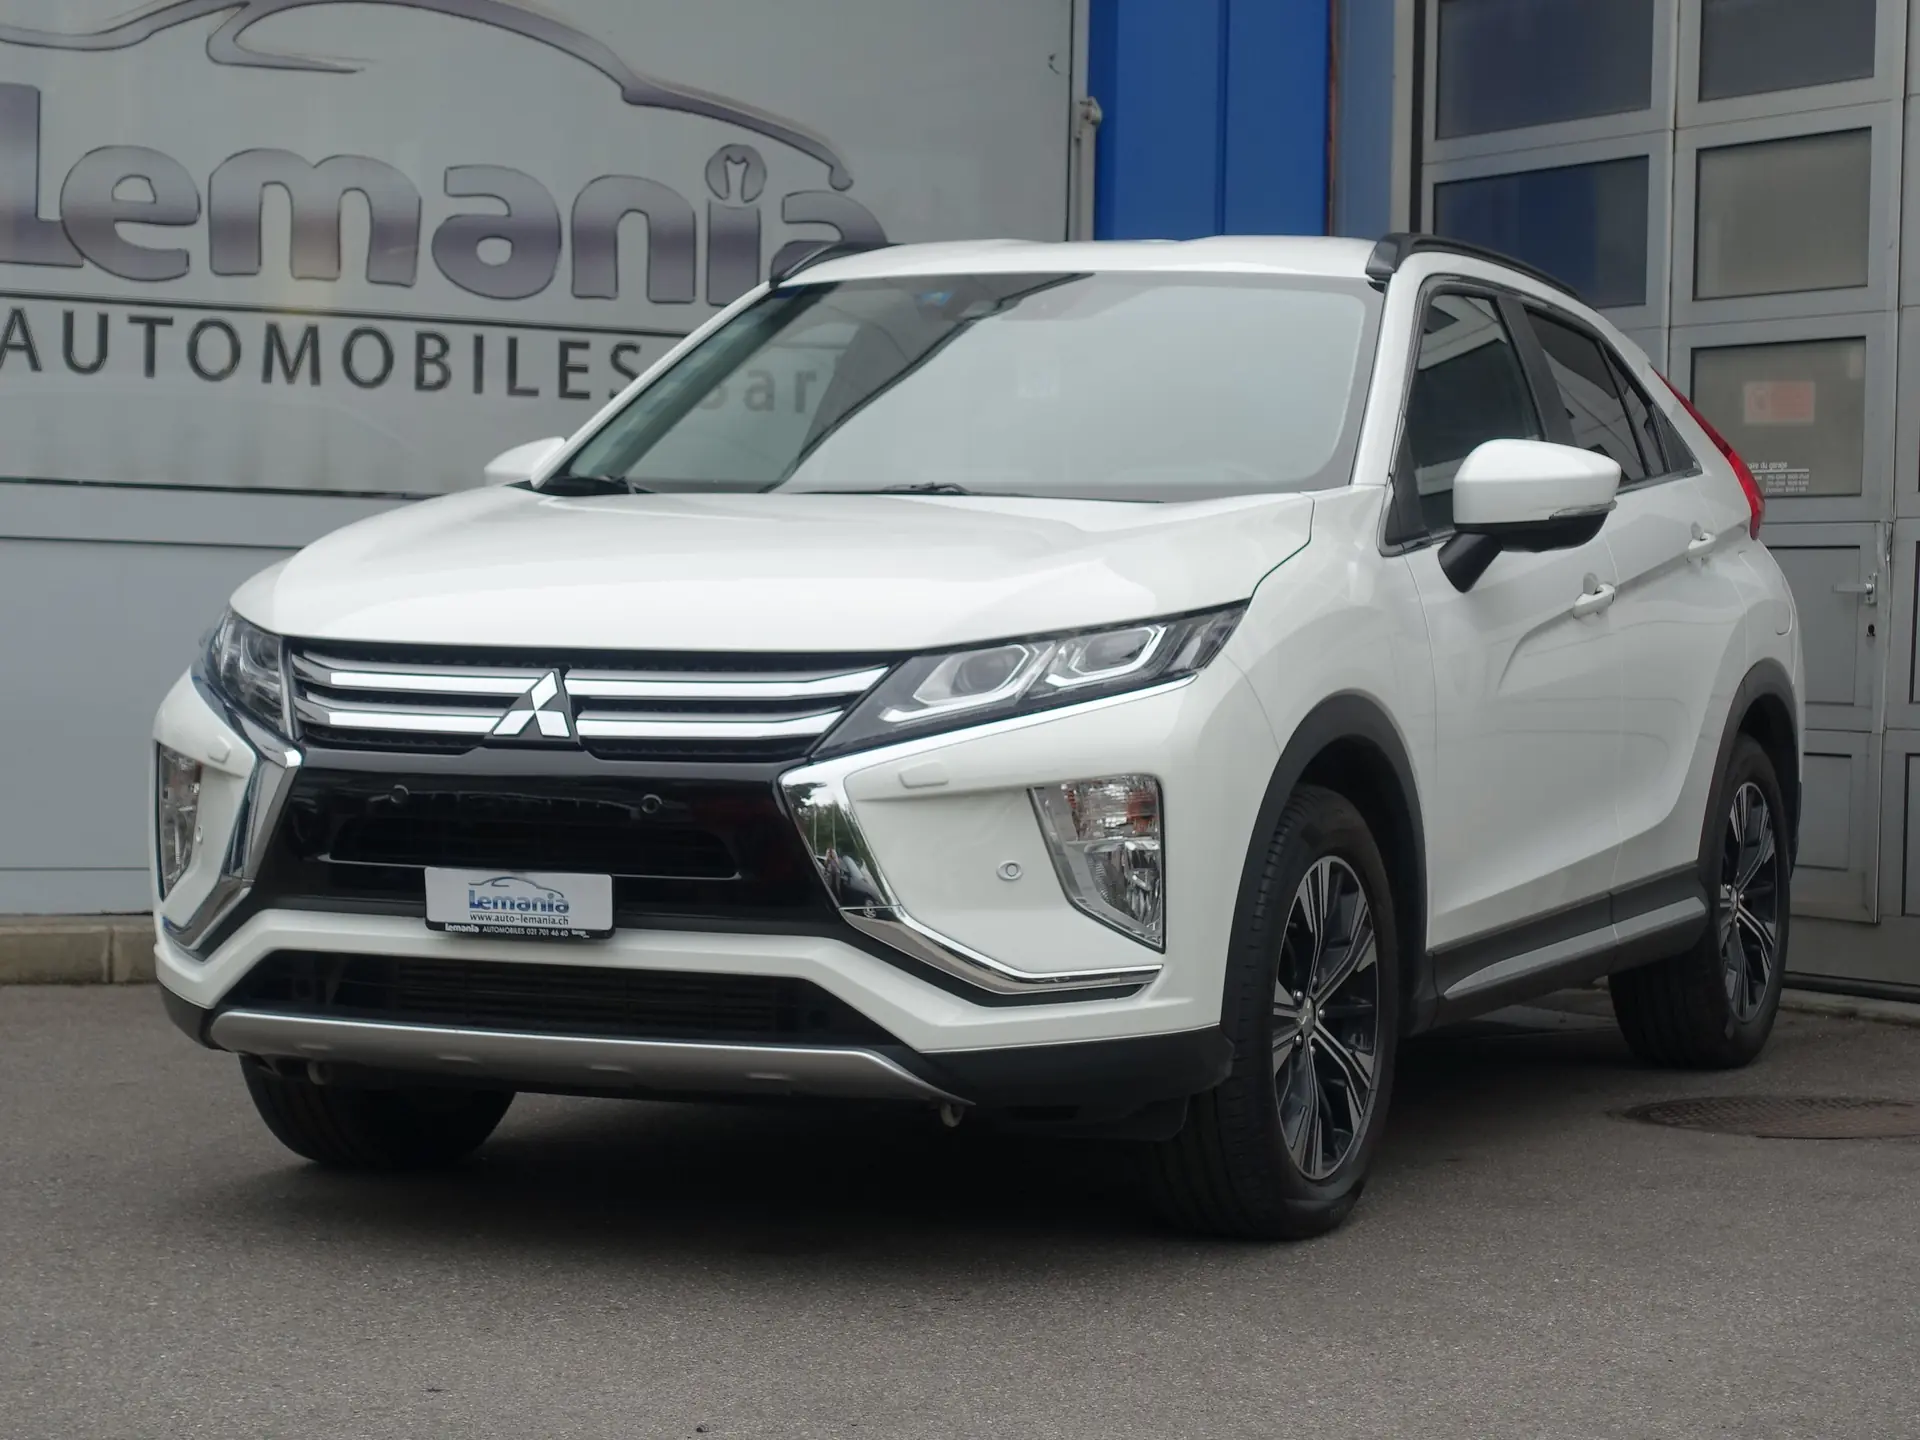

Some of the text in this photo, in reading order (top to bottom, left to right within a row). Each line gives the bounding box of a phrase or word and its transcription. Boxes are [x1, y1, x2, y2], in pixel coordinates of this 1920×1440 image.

[0, 84, 888, 307] Lemania
[0, 306, 641, 400] AUTOMOBILES
[468, 890, 569, 913] Lemania
[444, 922, 480, 933] Lemania
[482, 926, 526, 935] AUTOMOBILES
[469, 912, 569, 926] www.auto-lemania.ch
